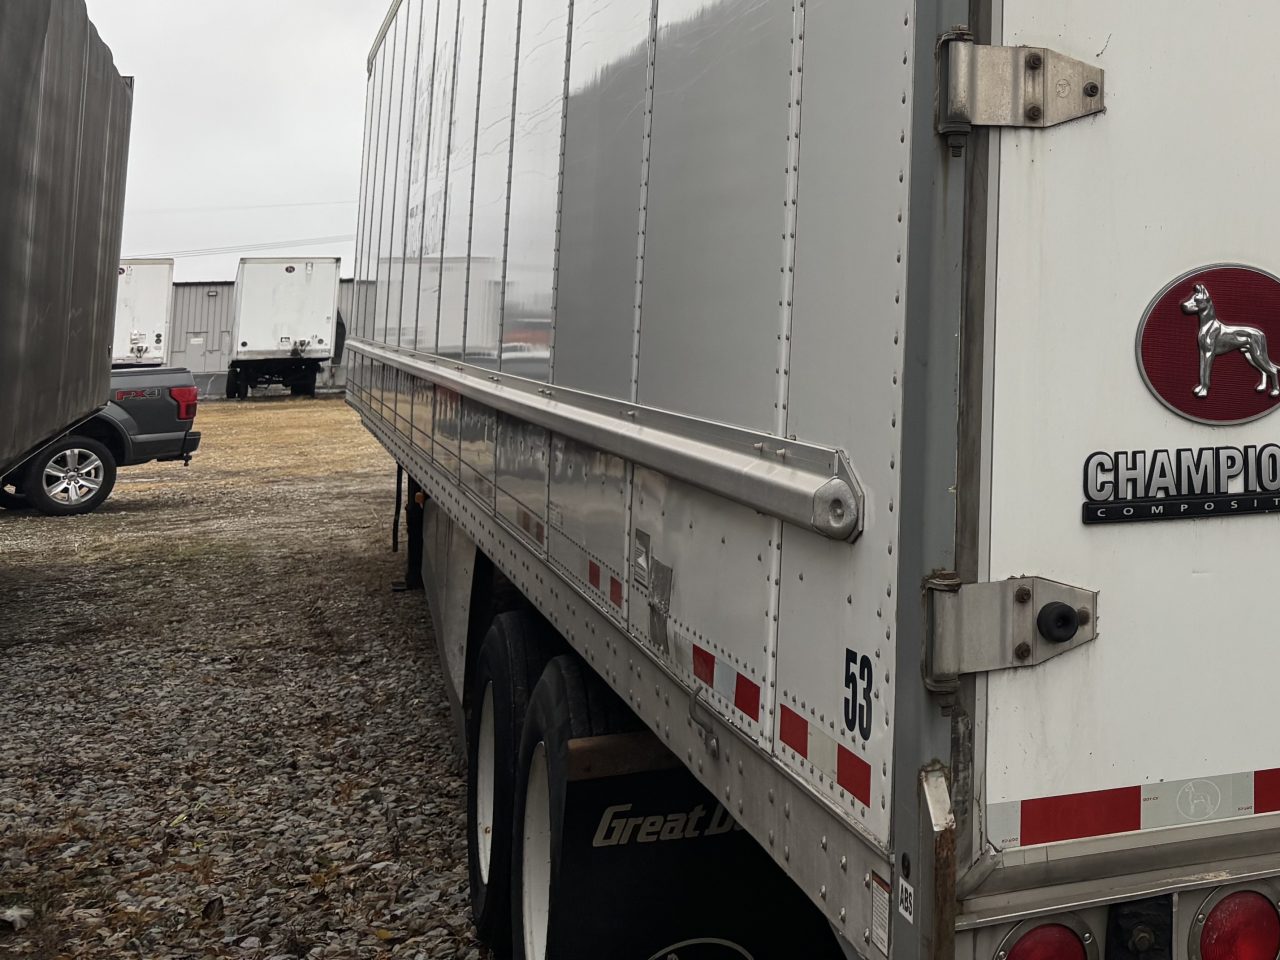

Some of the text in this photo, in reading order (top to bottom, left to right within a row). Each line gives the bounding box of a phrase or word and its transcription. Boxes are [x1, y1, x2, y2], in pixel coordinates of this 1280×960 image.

[844, 647, 873, 741] 53
[593, 803, 705, 847] Great
[899, 883, 913, 917] ABS
